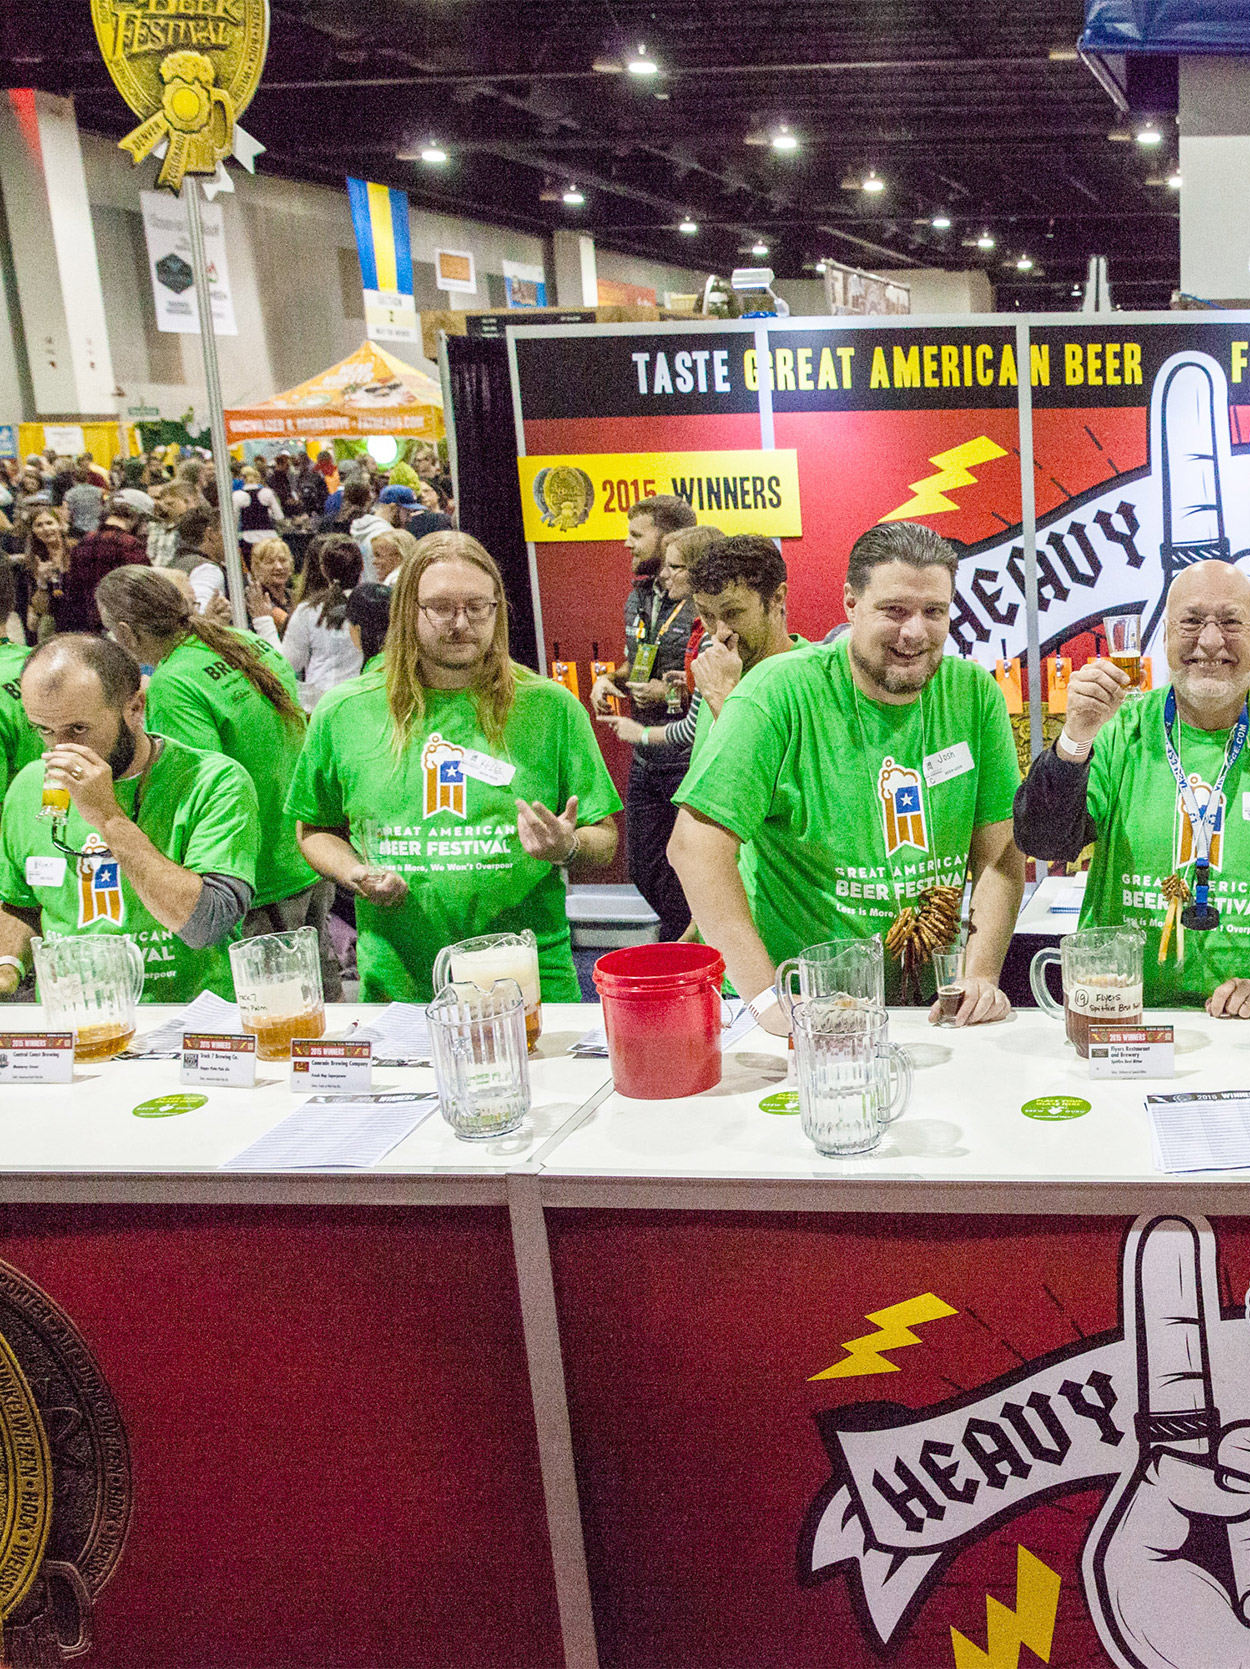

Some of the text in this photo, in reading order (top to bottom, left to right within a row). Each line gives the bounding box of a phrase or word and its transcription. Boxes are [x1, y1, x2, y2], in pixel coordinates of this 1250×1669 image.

[631, 348, 732, 396] TASTE
[743, 346, 855, 392] GREAT
[870, 342, 1050, 390] AMERICAN
[1064, 341, 1144, 387] BEER
[671, 476, 782, 511] WINNERS
[937, 750, 956, 764] Josh
[427, 824, 516, 837] AMERICAN
[379, 839, 512, 857] BEER FESTIVAL
[429, 863, 445, 872] We
[475, 861, 514, 873] Overpour
[834, 866, 886, 880] GREAT
[835, 879, 891, 901] BEER
[1096, 993, 1122, 1003] Flyers
[1109, 1033, 1146, 1042] 2015 WINNERS
[211, 1041, 232, 1050] WINNERS
[323, 1047, 345, 1056] WINNERS
[349, 1060, 369, 1068] Company
[1196, 1093, 1219, 1102] 2015
[870, 1369, 1124, 1534] HEAVY
[19, 1492, 39, 1533] BOCK
